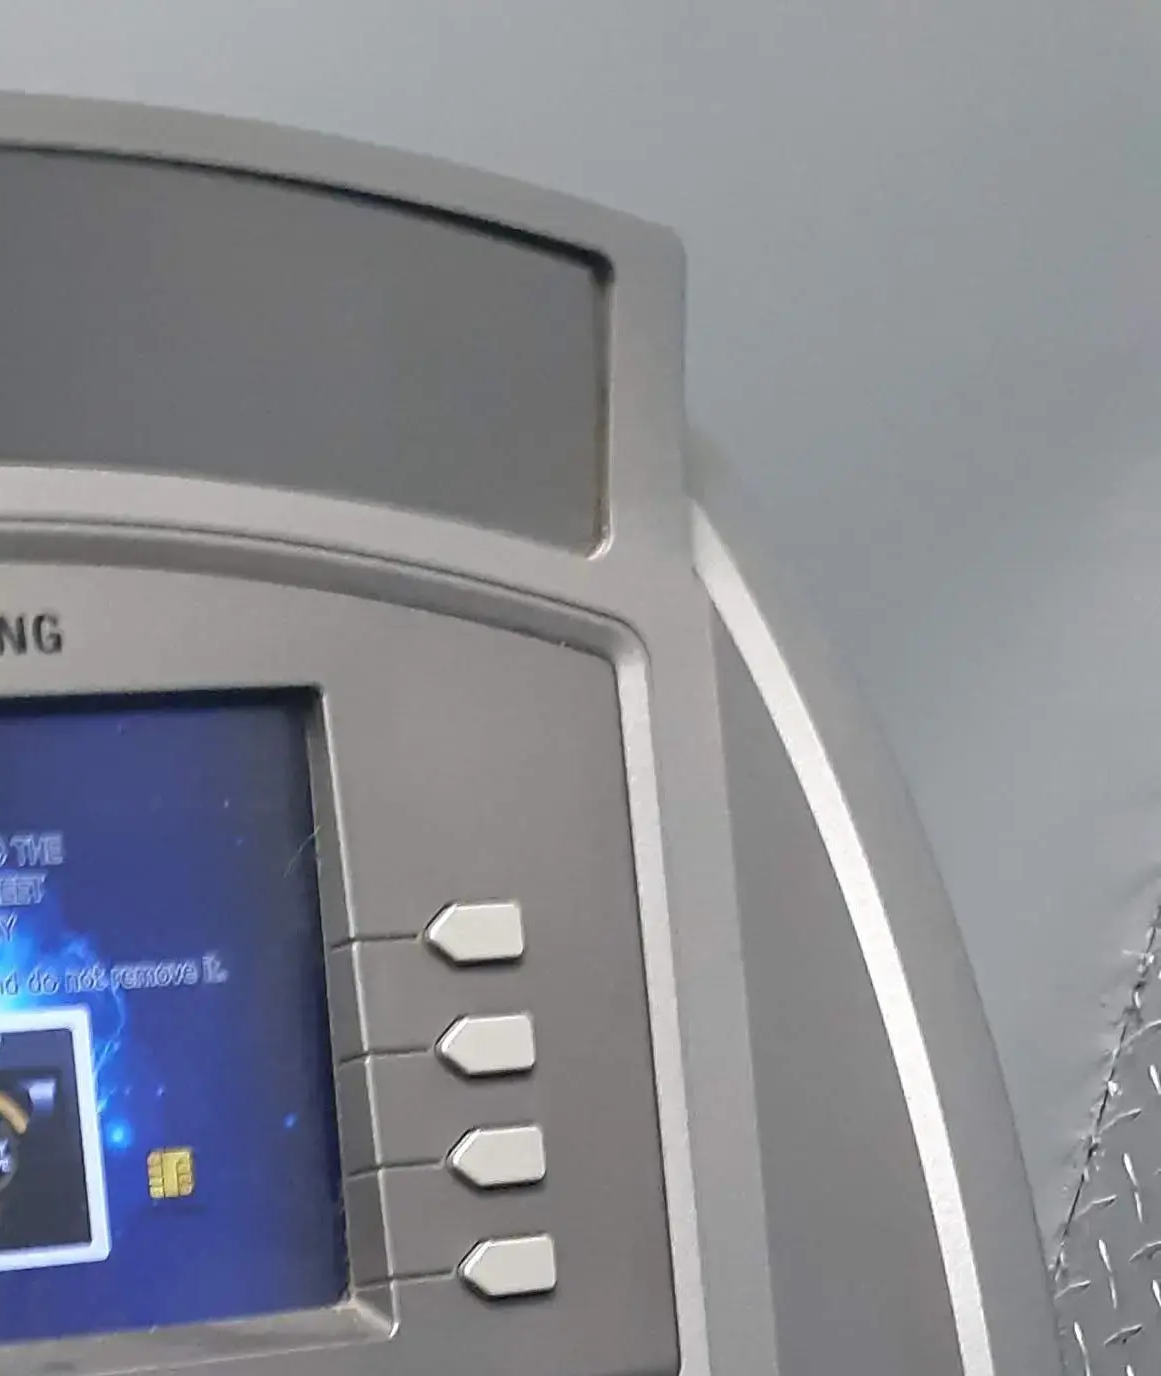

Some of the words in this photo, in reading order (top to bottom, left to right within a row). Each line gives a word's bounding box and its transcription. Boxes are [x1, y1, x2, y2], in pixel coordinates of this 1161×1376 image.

[10, 831, 65, 867] THE
[27, 968, 59, 995] do
[65, 963, 107, 993] not
[110, 956, 198, 990] remove
